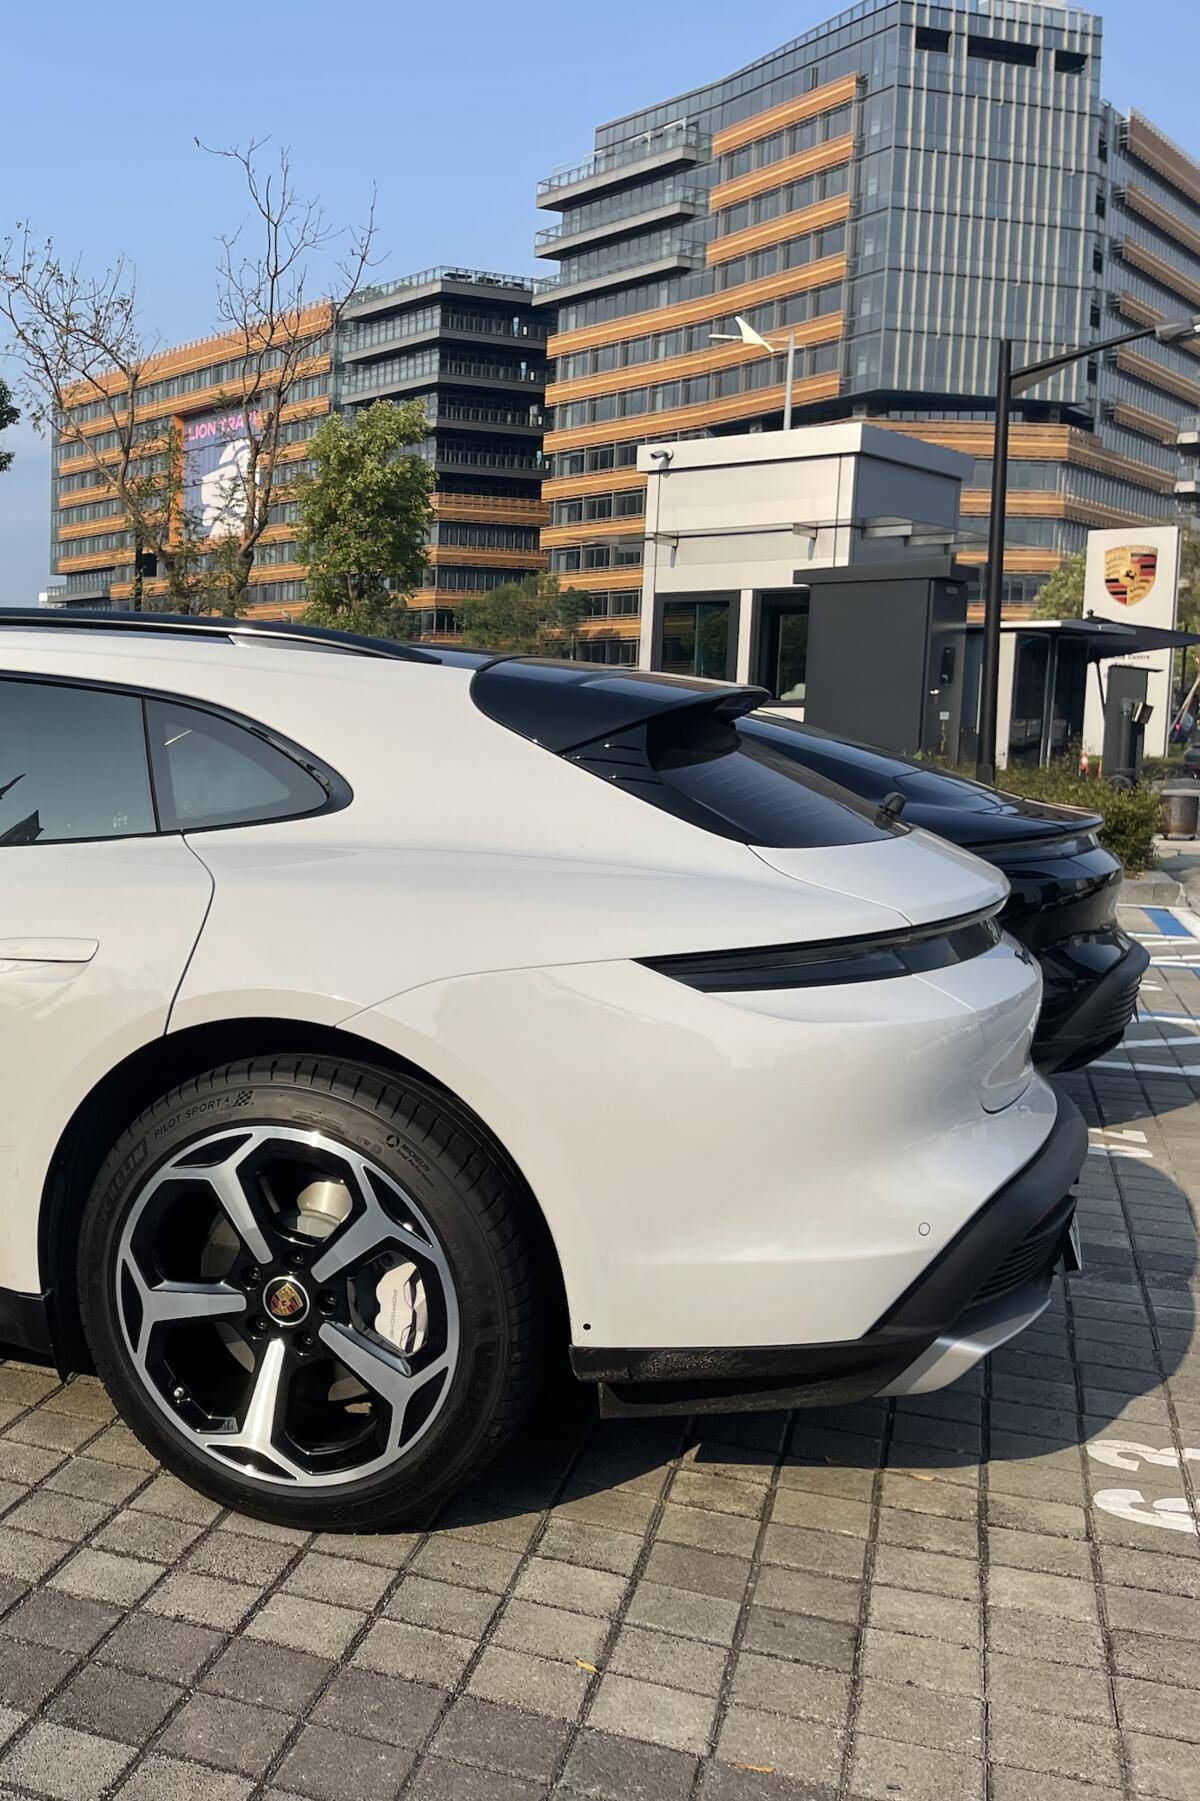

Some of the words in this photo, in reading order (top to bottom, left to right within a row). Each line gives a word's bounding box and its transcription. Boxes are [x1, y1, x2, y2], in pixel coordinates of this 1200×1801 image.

[188, 421, 216, 441] LION
[154, 1115, 182, 1139] PILOT
[185, 1098, 222, 1119] SPORT
[400, 1144, 431, 1172] MICHELIN
